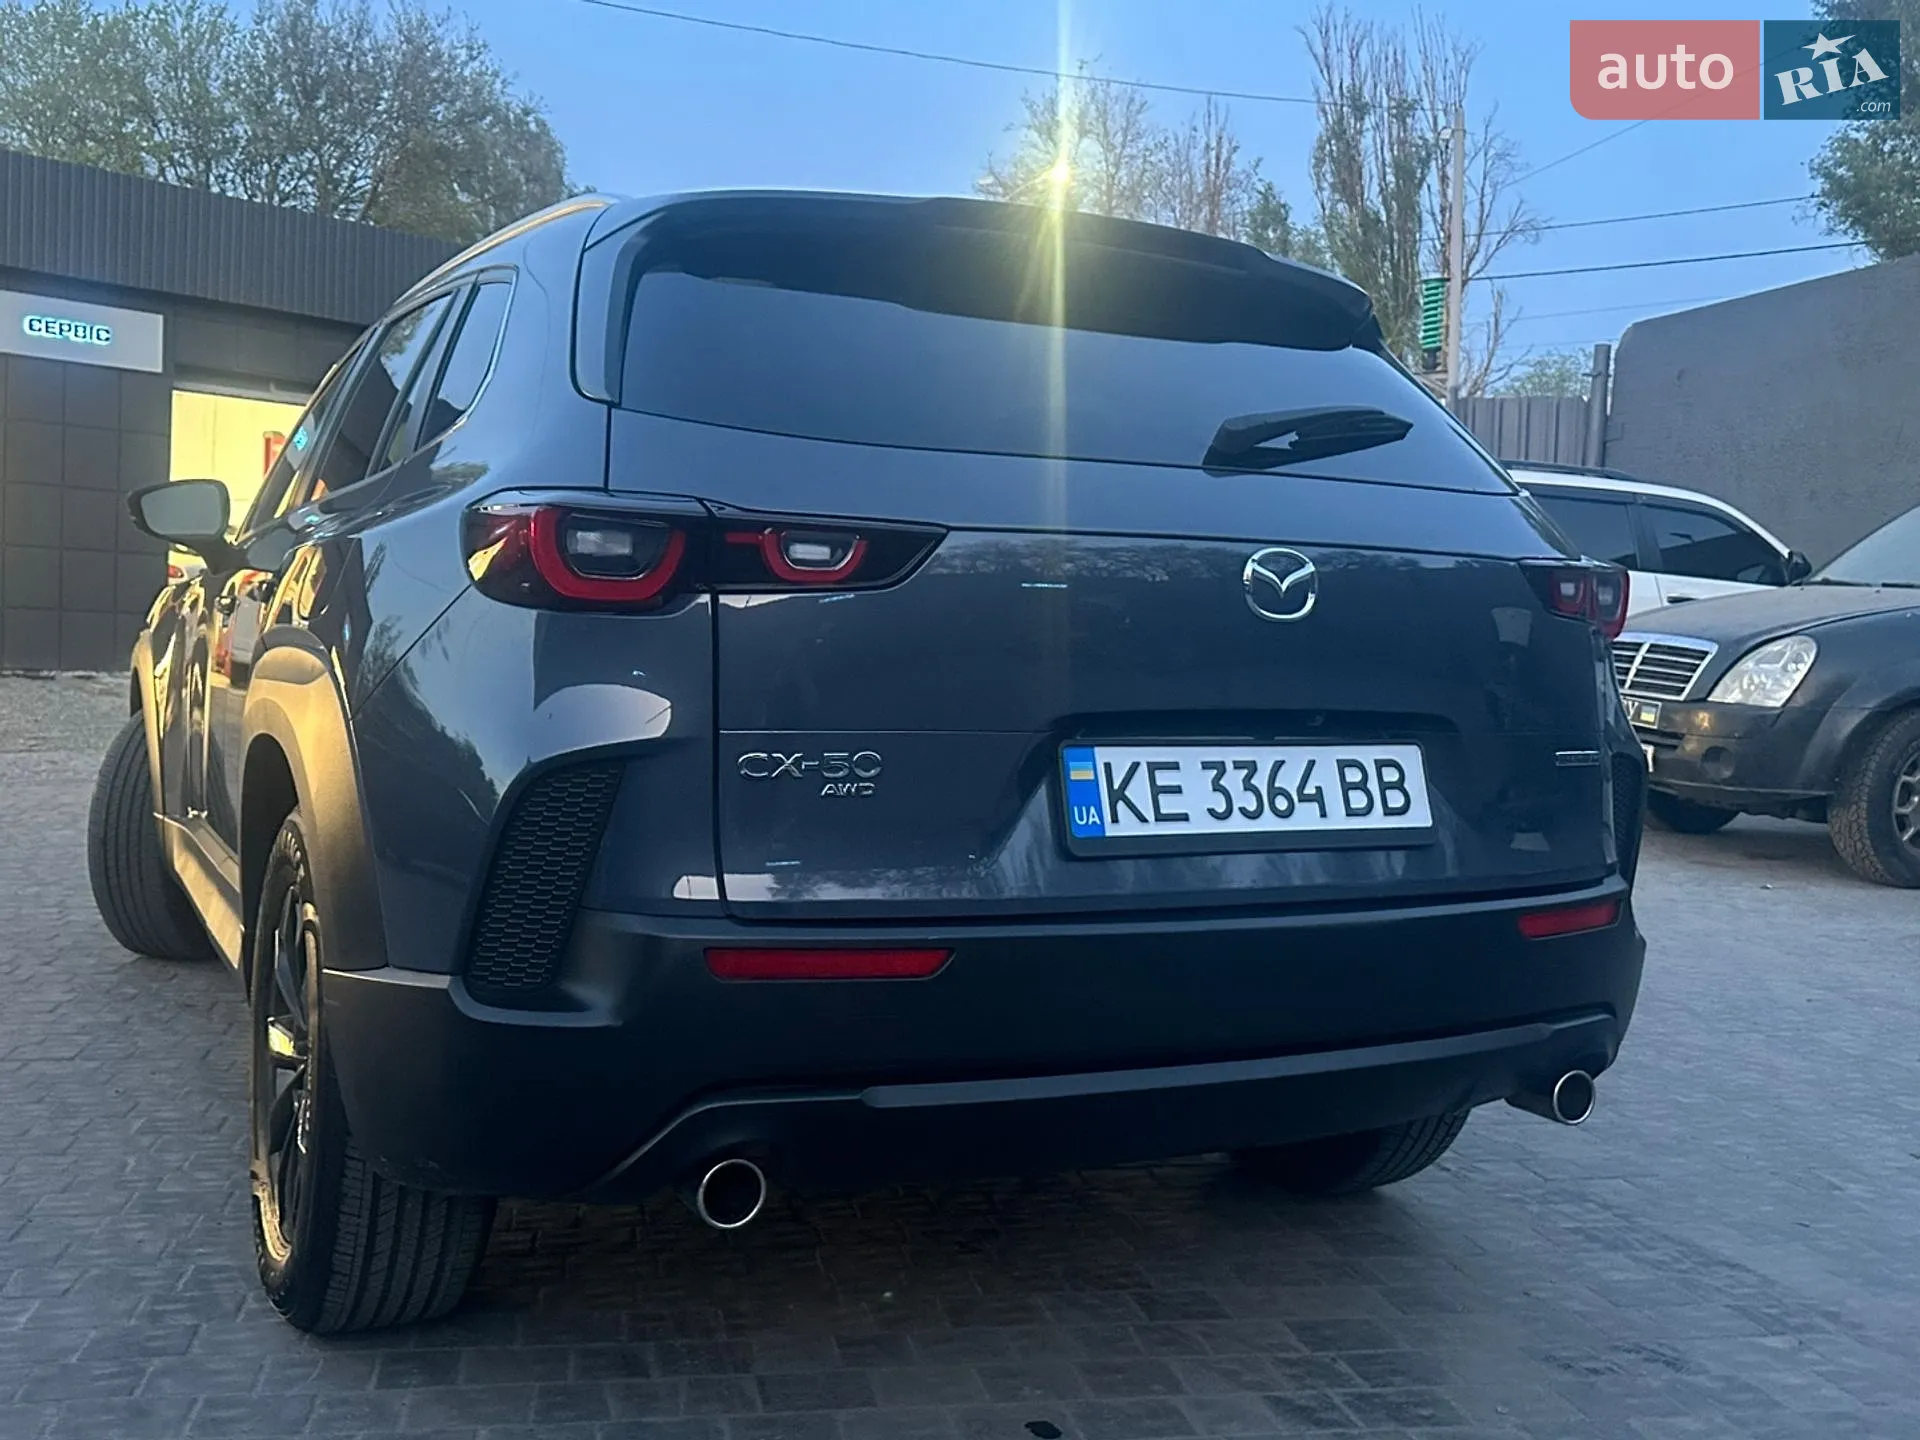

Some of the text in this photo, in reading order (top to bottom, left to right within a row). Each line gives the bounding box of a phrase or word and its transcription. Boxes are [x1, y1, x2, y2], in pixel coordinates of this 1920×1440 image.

[28, 317, 111, 342] СЕРВІС
[737, 750, 883, 779] CX-50
[820, 782, 876, 796] AWD
[1103, 757, 1412, 824] KE 3364 BB
[1074, 805, 1101, 826] UA
